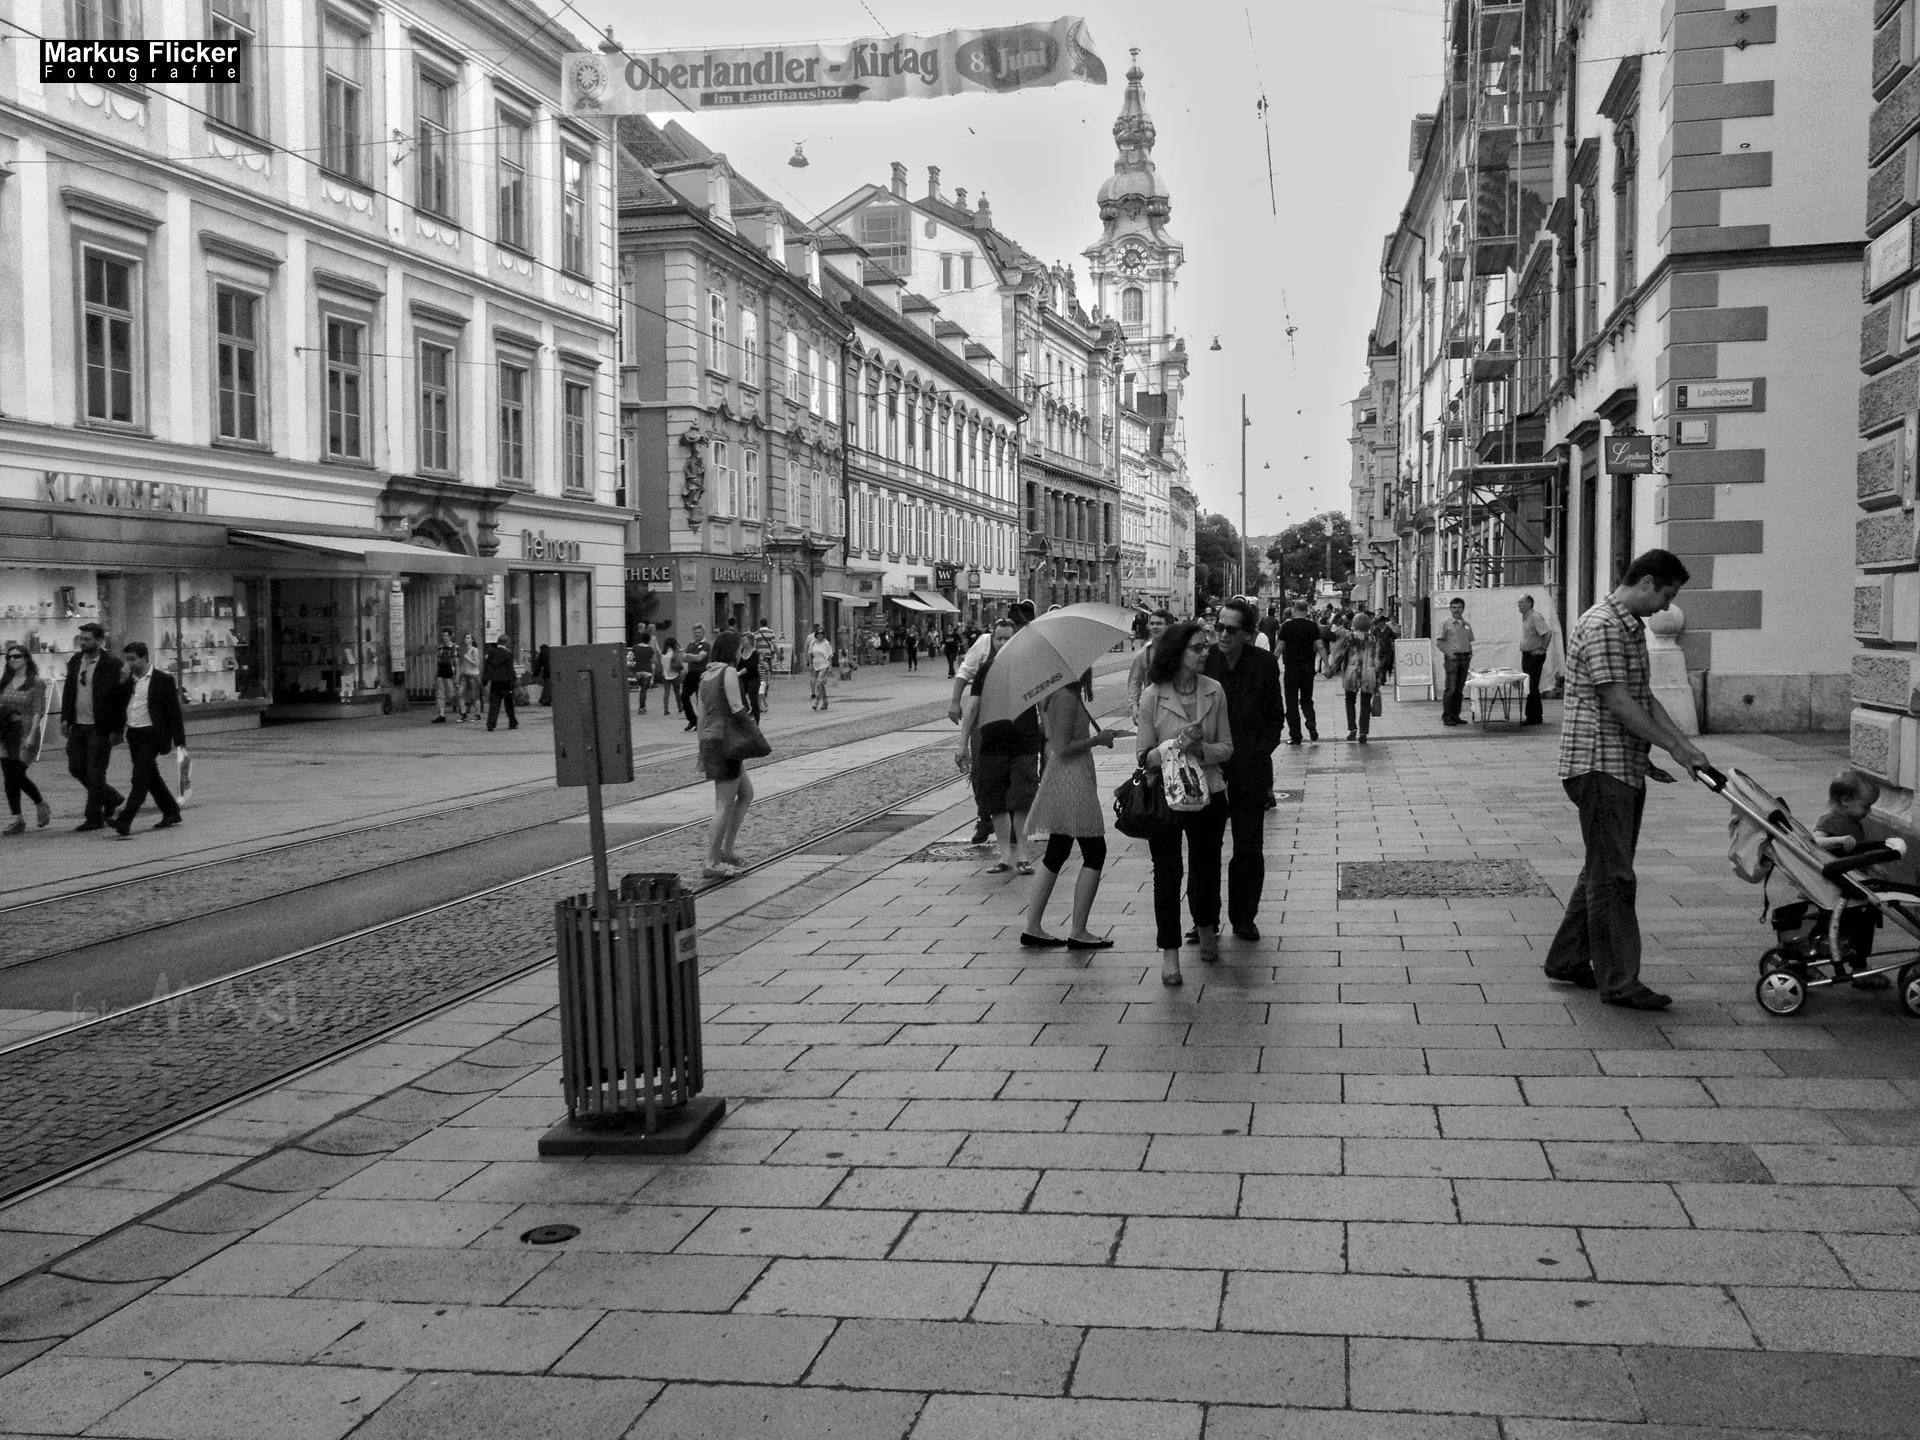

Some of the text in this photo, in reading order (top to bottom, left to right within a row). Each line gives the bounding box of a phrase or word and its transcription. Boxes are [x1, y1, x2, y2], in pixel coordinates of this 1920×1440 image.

[625, 51, 820, 91] Oberlandler
[852, 42, 939, 86] Kirtag
[997, 40, 1048, 79] Juni
[713, 87, 846, 104] im Landhaushof
[1698, 387, 1749, 398] Landhausgasse
[44, 470, 209, 515] KLAMMERTH
[1400, 652, 1424, 667] -30
[1022, 672, 1063, 701] TEZENIS
